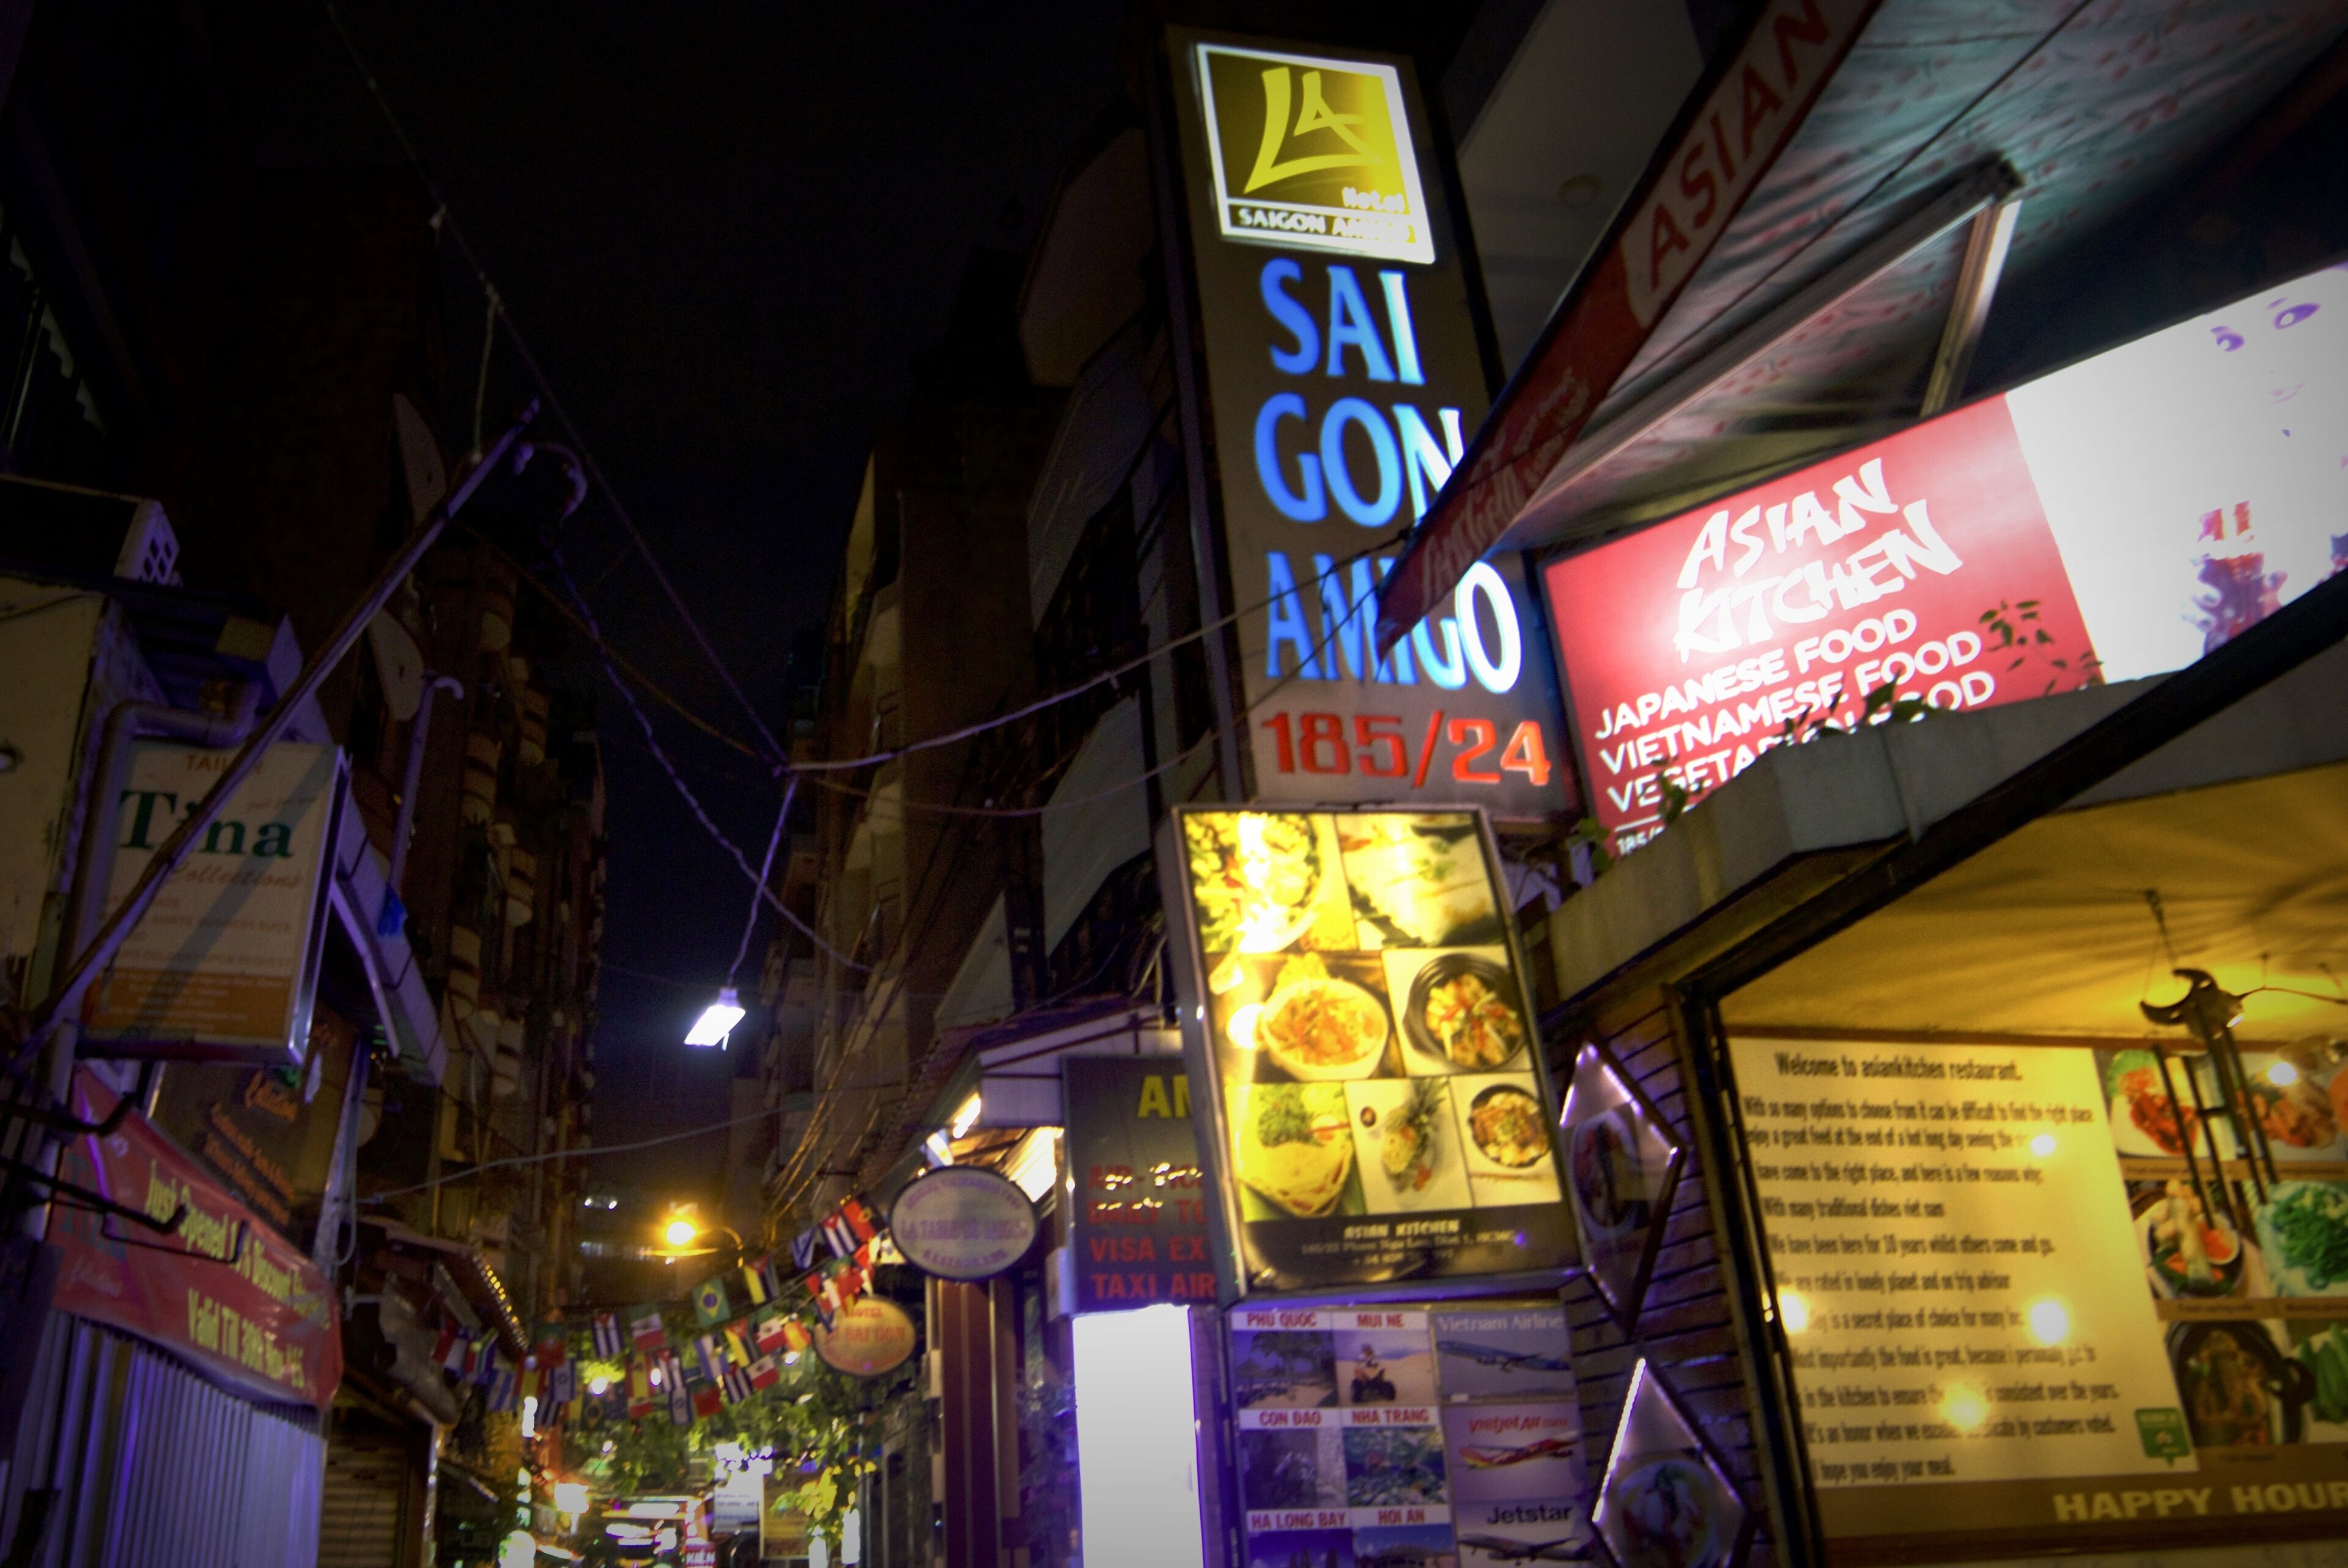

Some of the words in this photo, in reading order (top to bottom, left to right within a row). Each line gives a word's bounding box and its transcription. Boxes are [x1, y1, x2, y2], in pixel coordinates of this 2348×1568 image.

[1650, 0, 1831, 292] ASIAN
[1238, 207, 1326, 234] SAIGON
[1260, 257, 1425, 386] SAI
[1254, 392, 1465, 529] GON
[1677, 458, 1898, 588] ASIAN
[1673, 499, 1962, 663] KITCHEN
[1596, 649, 1790, 740] JAPANESE
[1794, 609, 1917, 674] FOOD
[1600, 671, 1845, 775] VIETNAMESE
[1855, 631, 1982, 697] FOOD
[1260, 710, 1551, 789] 185/24
[119, 789, 294, 858] Tna
[1089, 1235, 1156, 1262] VISA
[1168, 1235, 1211, 1262] EX
[851, 1306, 884, 1318] OTEL
[1091, 1272, 1157, 1300] TAXI
[1438, 1316, 1507, 1332] Vietnam
[1487, 1504, 1573, 1525] Jetstar
[2053, 1487, 2214, 1522] HAPPY
